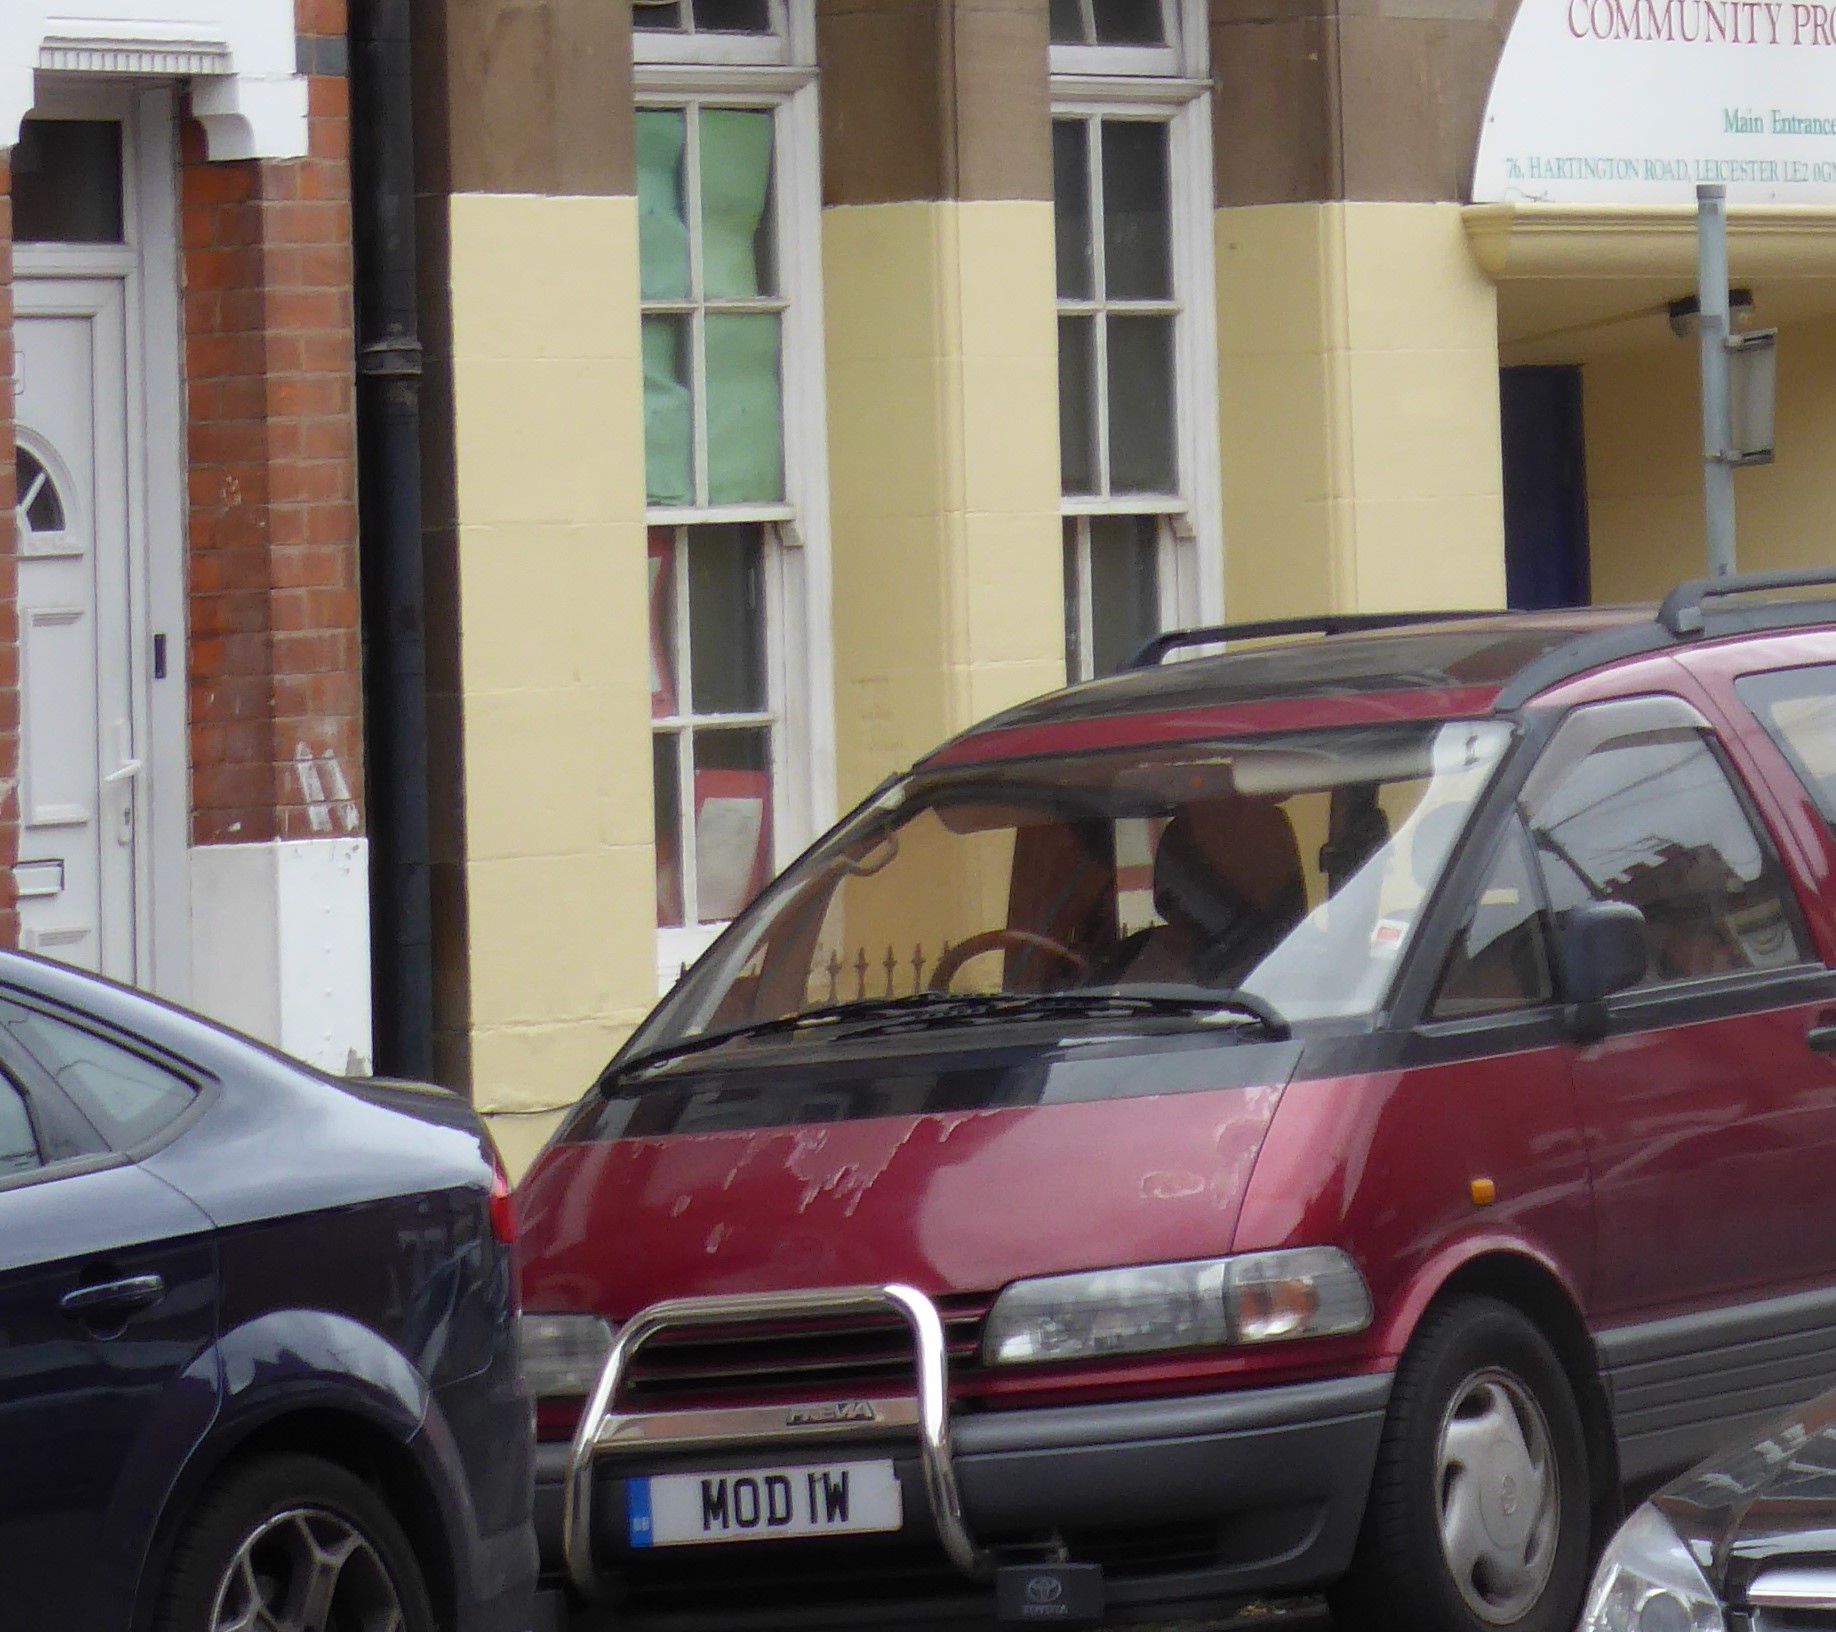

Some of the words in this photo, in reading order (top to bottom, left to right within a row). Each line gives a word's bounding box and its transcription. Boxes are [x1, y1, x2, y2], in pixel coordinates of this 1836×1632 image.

[1723, 107, 1764, 134] Main
[1528, 156, 1639, 180] HARTINGTON
[1644, 158, 1691, 182] ROAD,
[1695, 160, 1779, 182] LEICESTER
[1783, 160, 1808, 183] LE2
[701, 1475, 794, 1531] MOD
